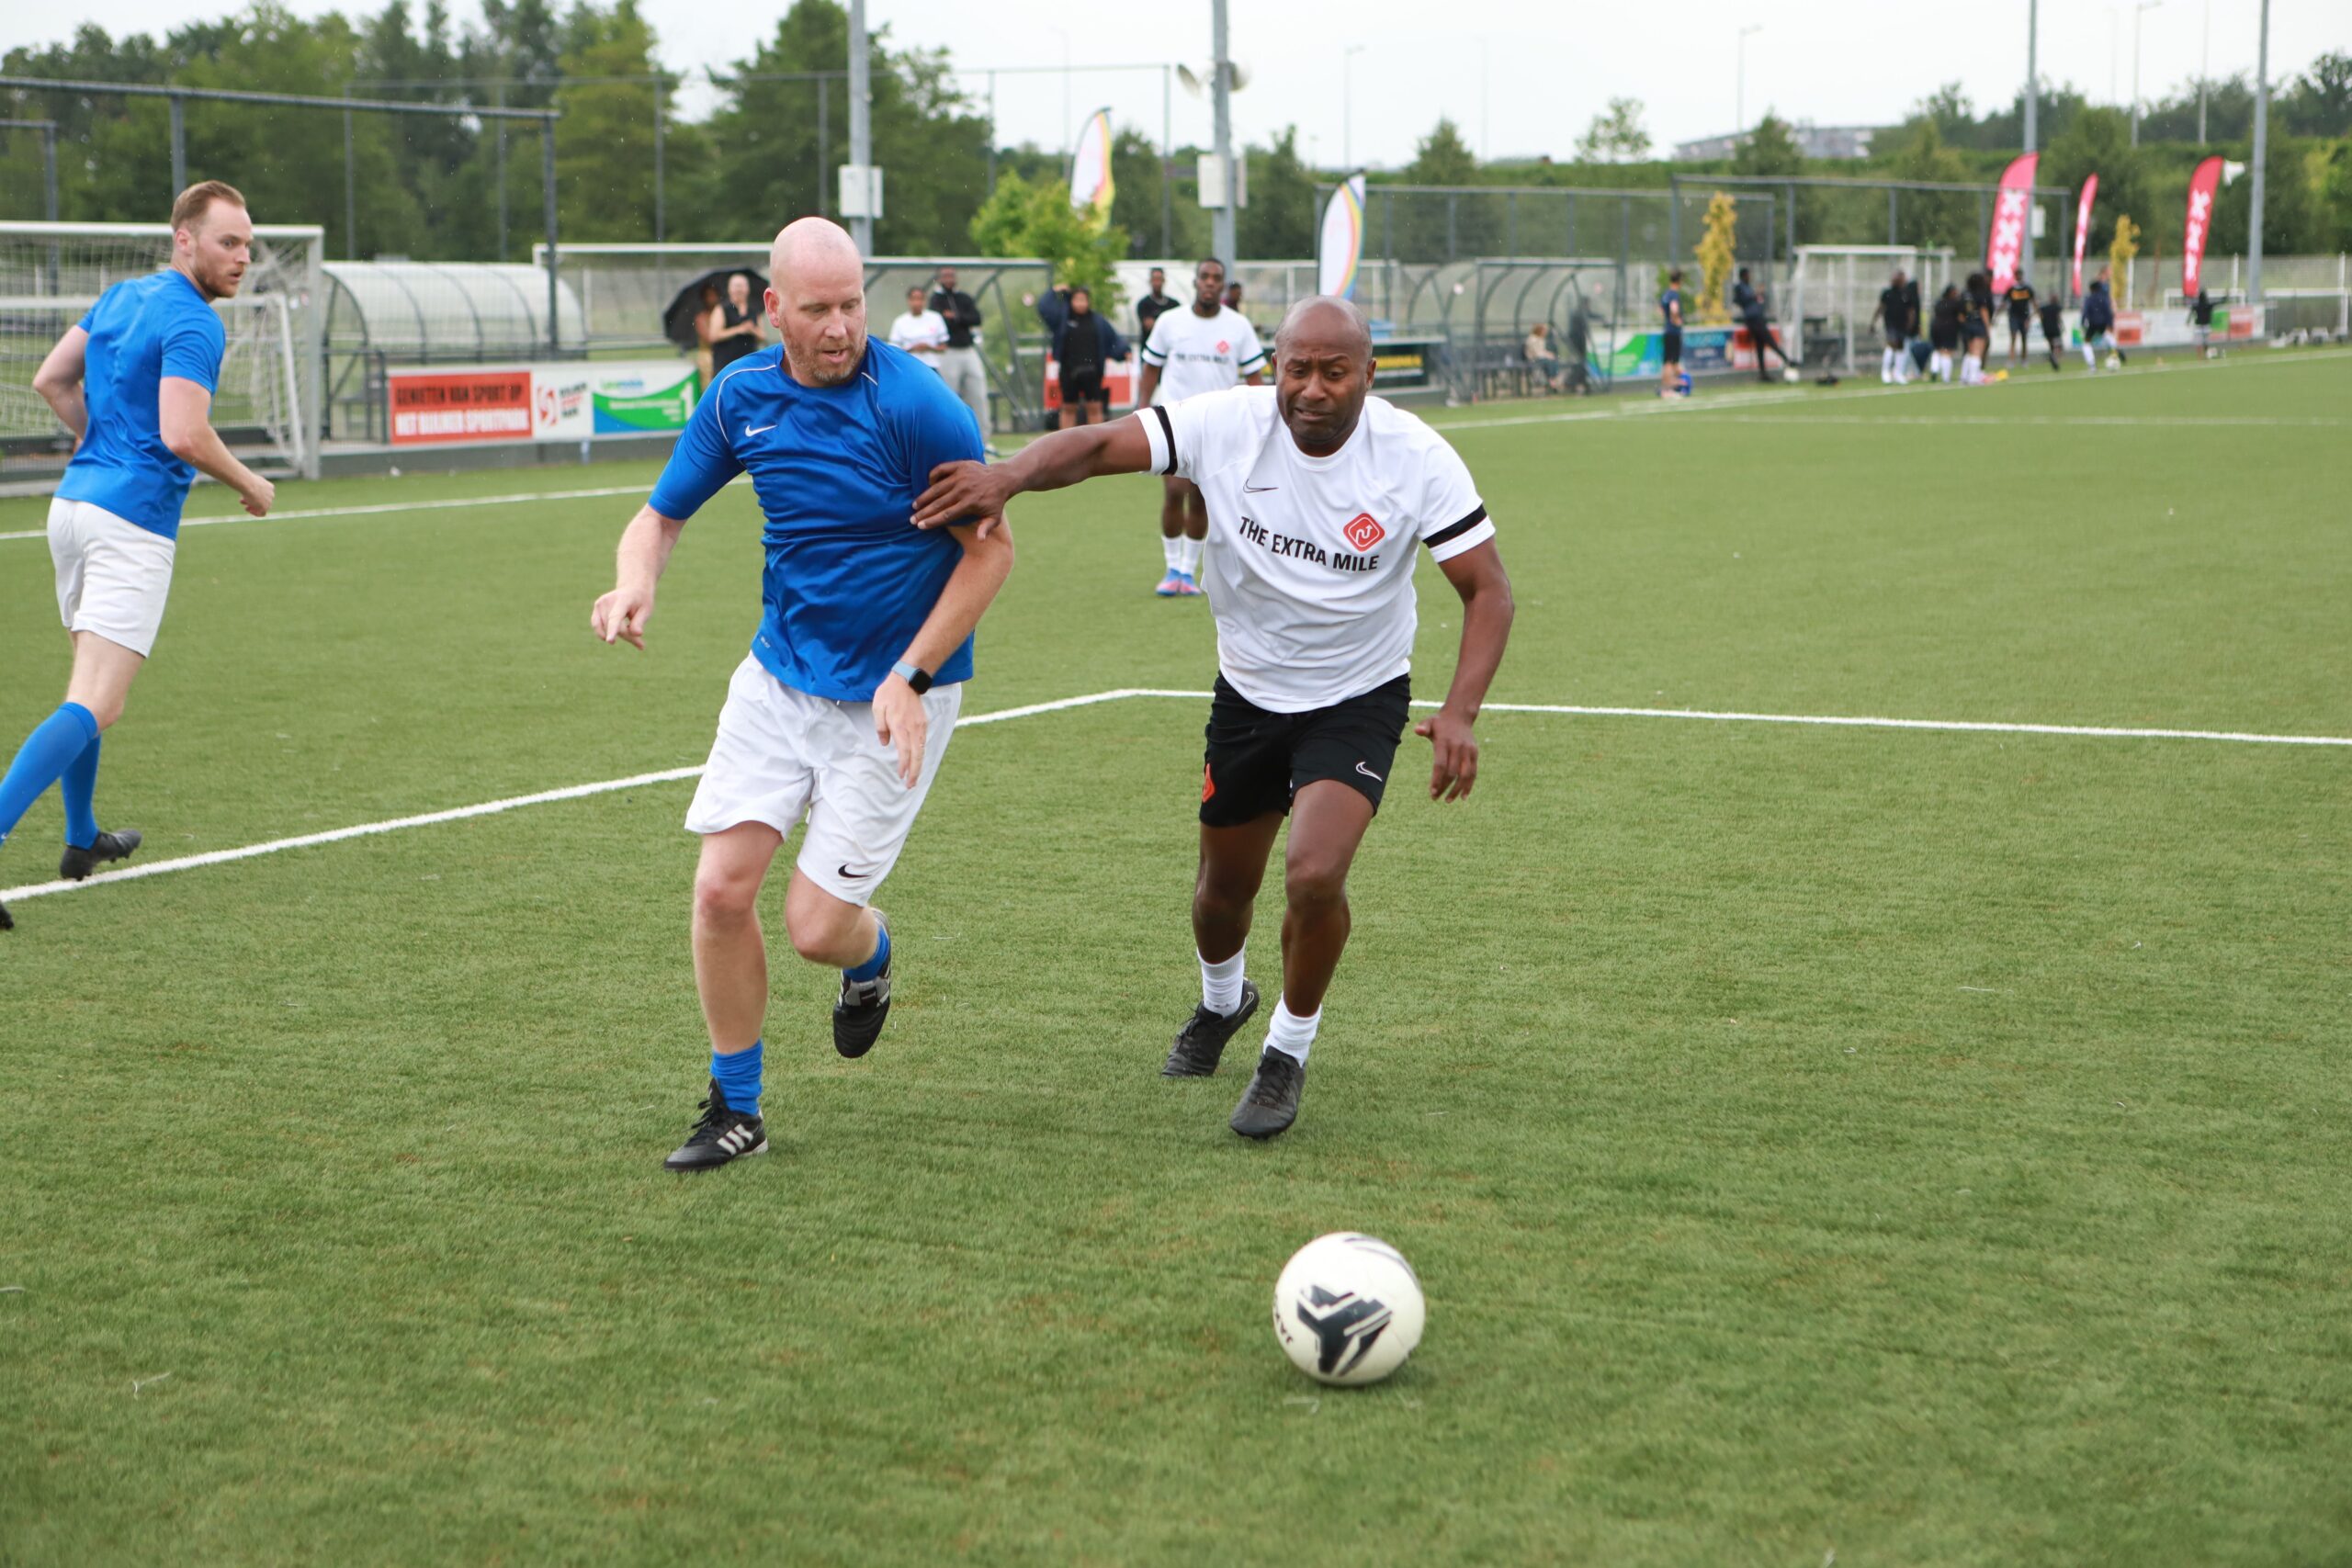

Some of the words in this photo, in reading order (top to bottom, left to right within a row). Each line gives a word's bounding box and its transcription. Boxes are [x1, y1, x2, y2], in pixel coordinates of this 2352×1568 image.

[1239, 516, 1269, 547] THE
[1271, 534, 1327, 566] EXTRA
[1332, 553, 1380, 572] MILE
